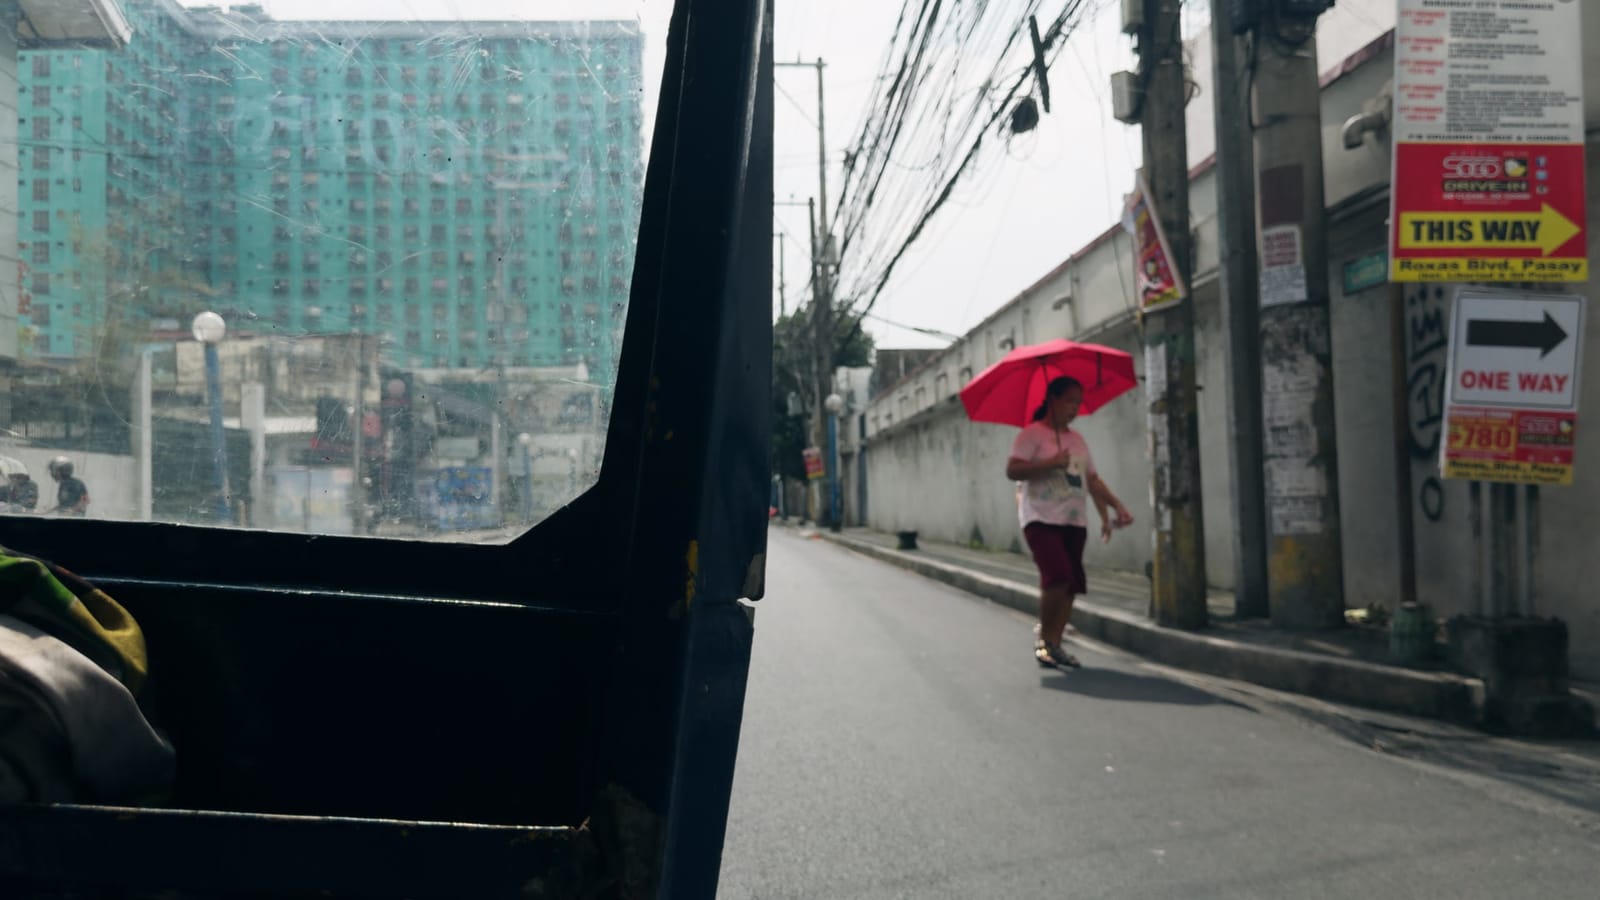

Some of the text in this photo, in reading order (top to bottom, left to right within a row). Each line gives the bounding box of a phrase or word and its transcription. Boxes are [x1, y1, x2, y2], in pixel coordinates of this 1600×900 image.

[1443, 181, 1527, 193] DRIVE-IN
[1411, 220, 1541, 242] THIS WAY
[1399, 259, 1460, 271] Roxas
[1522, 260, 1582, 273] Pasay
[1460, 370, 1569, 394] ONE WAY
